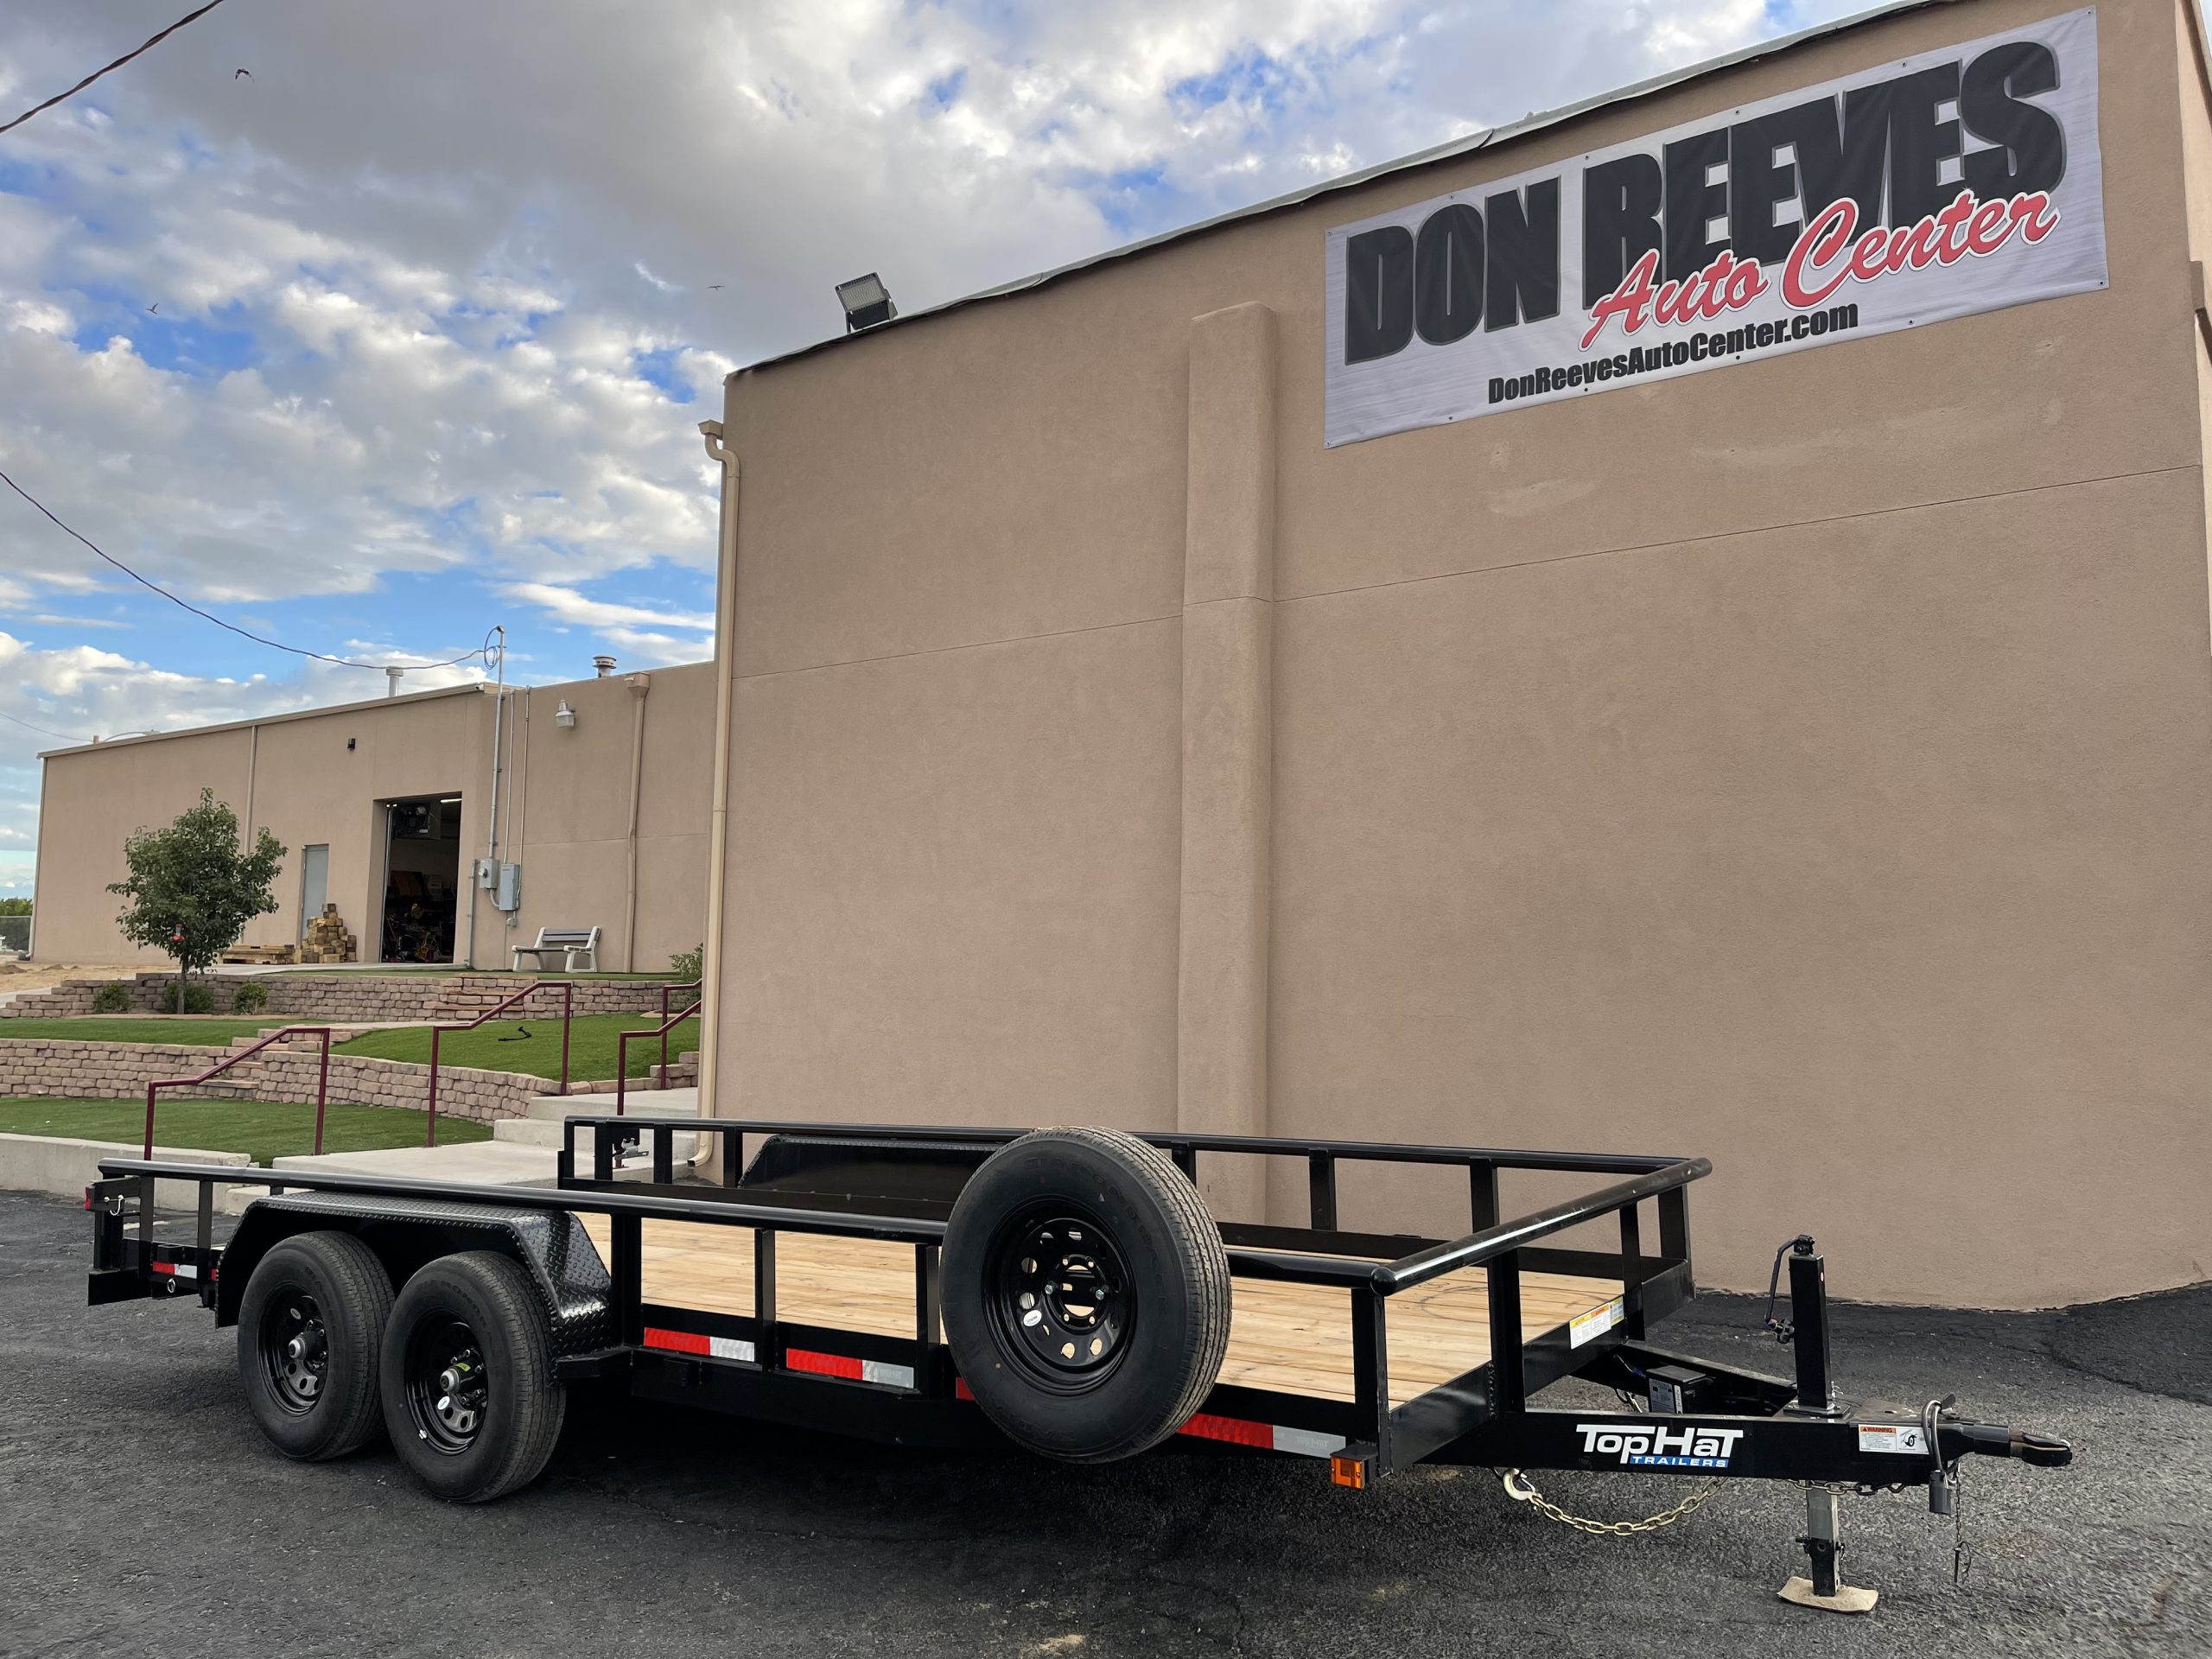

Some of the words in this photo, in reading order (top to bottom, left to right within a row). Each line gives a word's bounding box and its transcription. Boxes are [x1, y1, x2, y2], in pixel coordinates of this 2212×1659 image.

[1345, 175, 1560, 365] DON
[1582, 41, 2067, 310] REEVES
[1580, 249, 1770, 352] Auto
[1781, 188, 2063, 311] Center
[1488, 302, 1859, 404] DonReevesAutoCenter.com
[1632, 1455, 1727, 1467] TRAILERS
